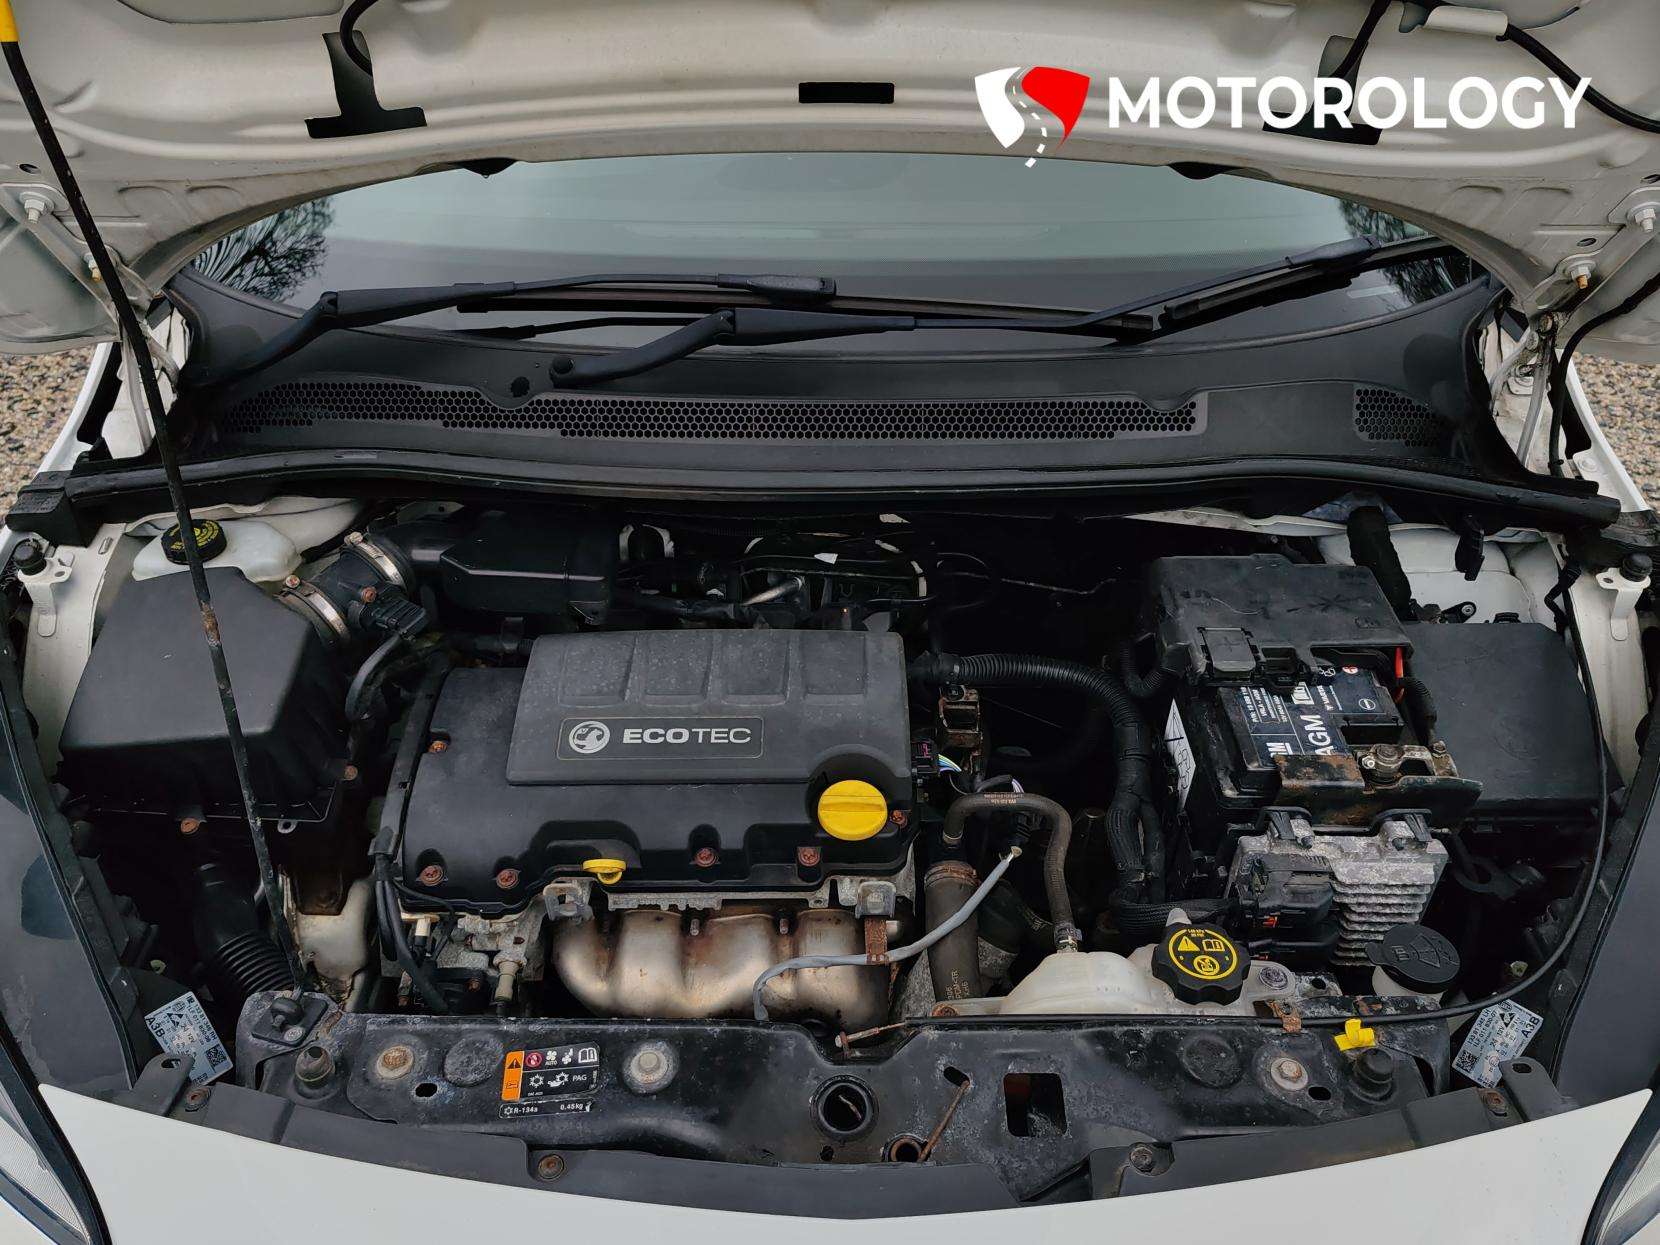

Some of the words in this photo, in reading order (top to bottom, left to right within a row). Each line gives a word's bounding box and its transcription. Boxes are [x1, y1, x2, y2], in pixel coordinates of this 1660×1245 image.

[622, 727, 752, 744] ECOTEC
[1300, 715, 1334, 756] AGM
[146, 1017, 165, 1038] A3B
[1521, 1016, 1540, 1038] A3B
[572, 1074, 588, 1082] PAG
